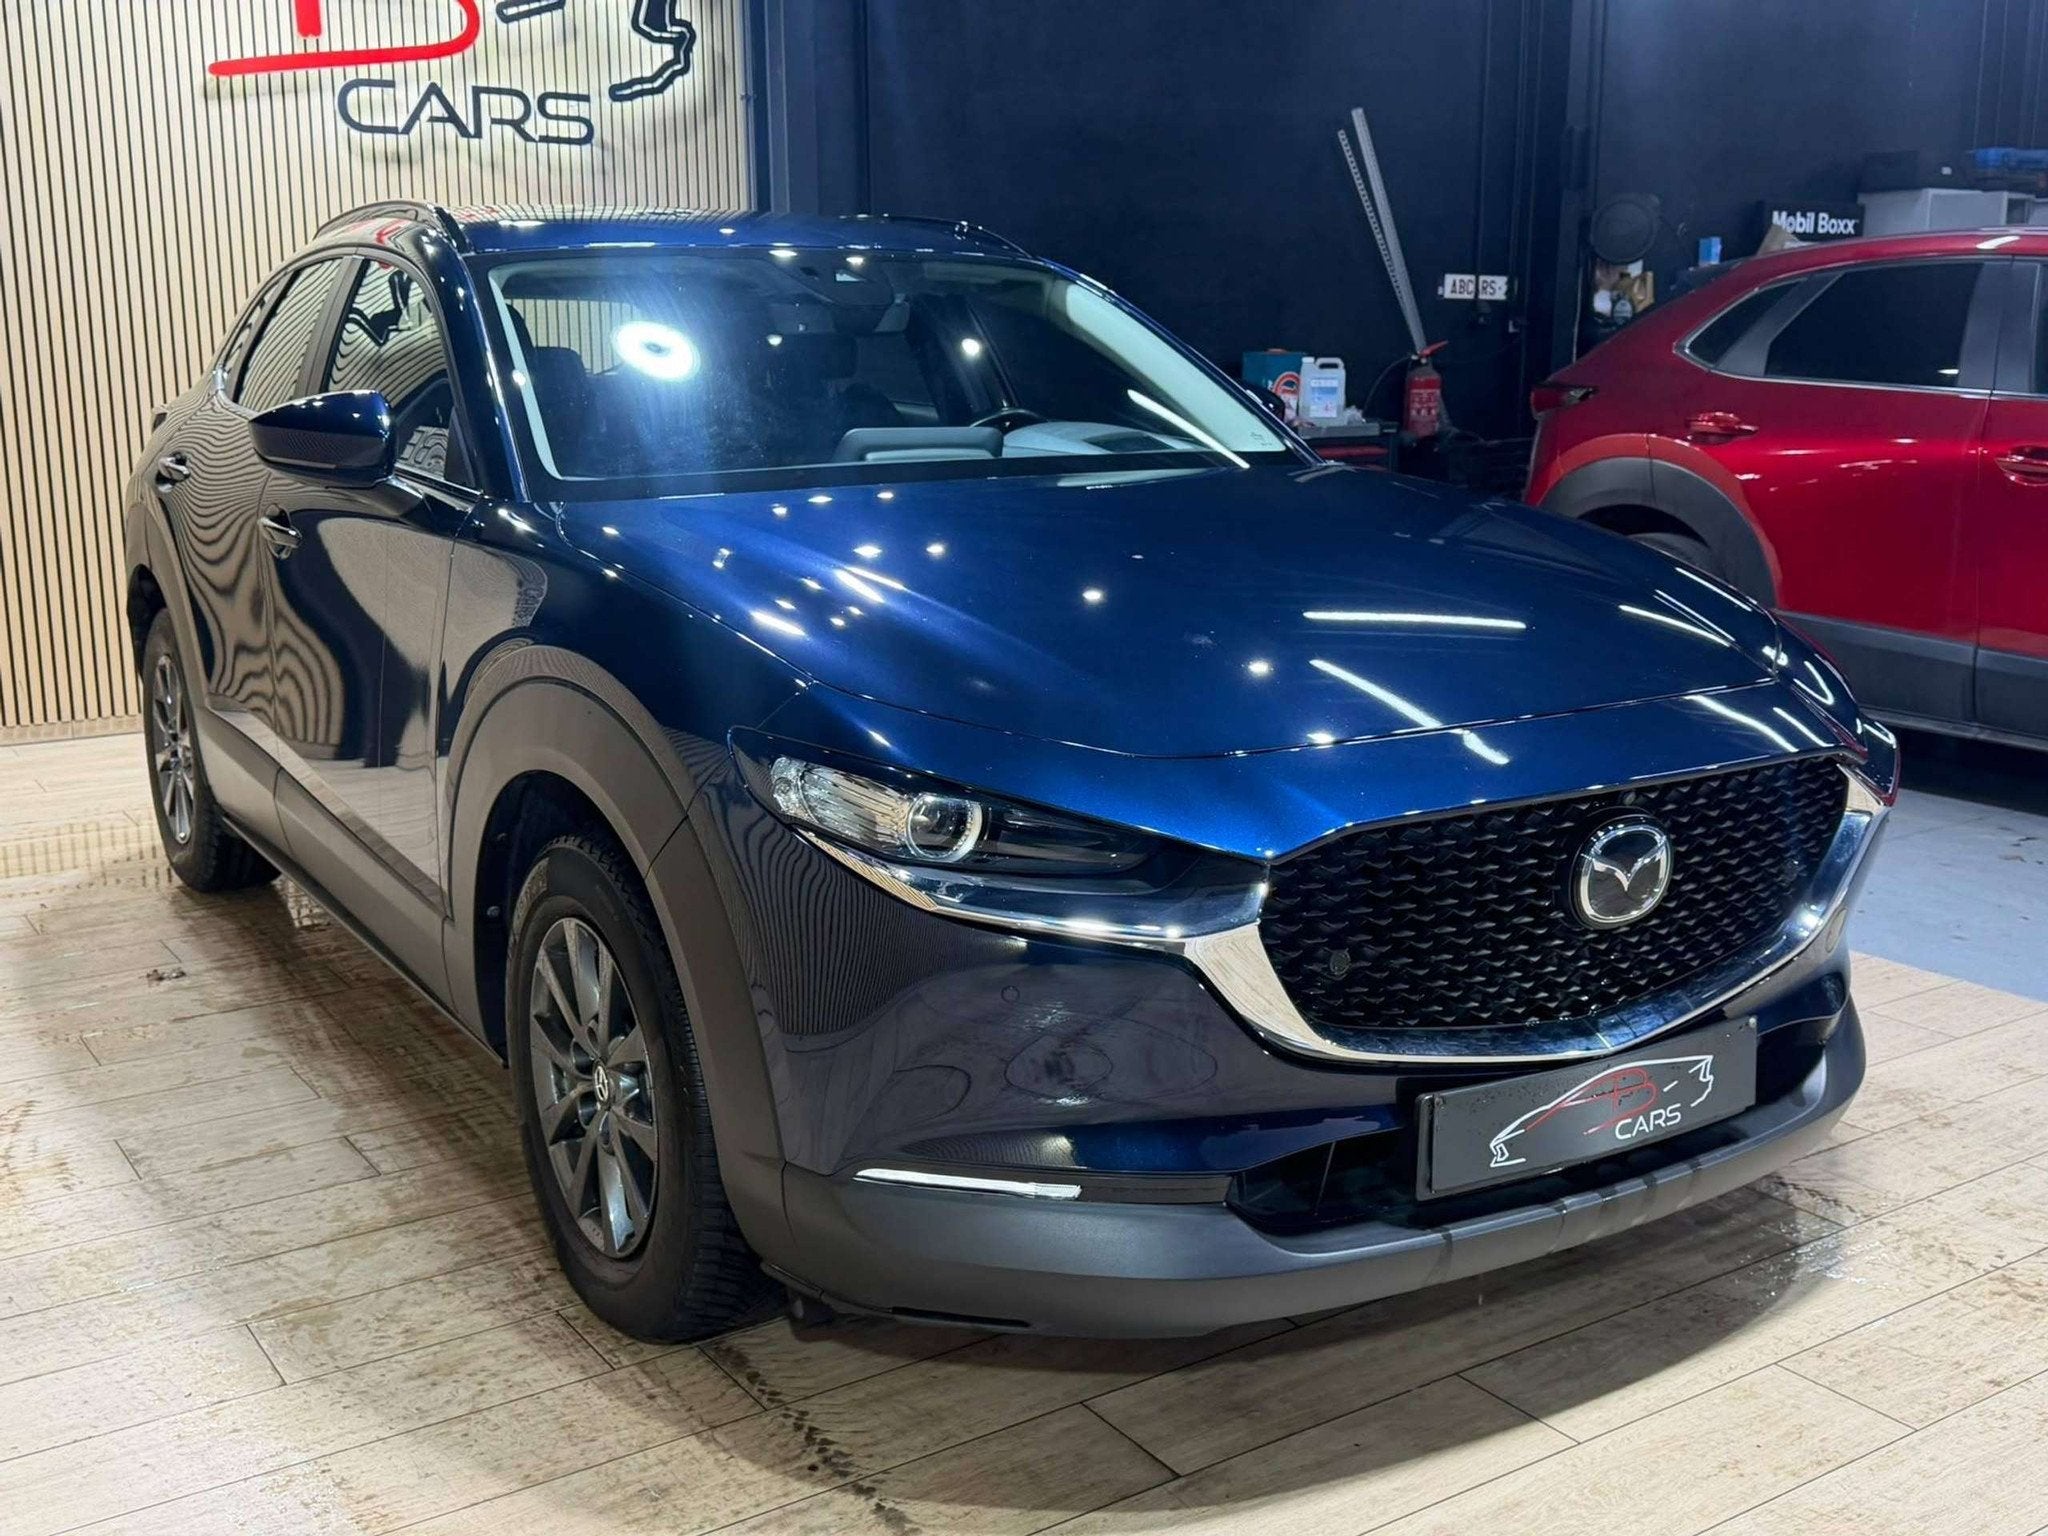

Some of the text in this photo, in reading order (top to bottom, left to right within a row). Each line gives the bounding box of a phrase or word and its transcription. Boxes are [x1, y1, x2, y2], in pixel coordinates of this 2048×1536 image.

[337, 78, 595, 146] CARS
[1772, 211, 1856, 234] Mobil Boxx
[1615, 1103, 1682, 1140] CARS
